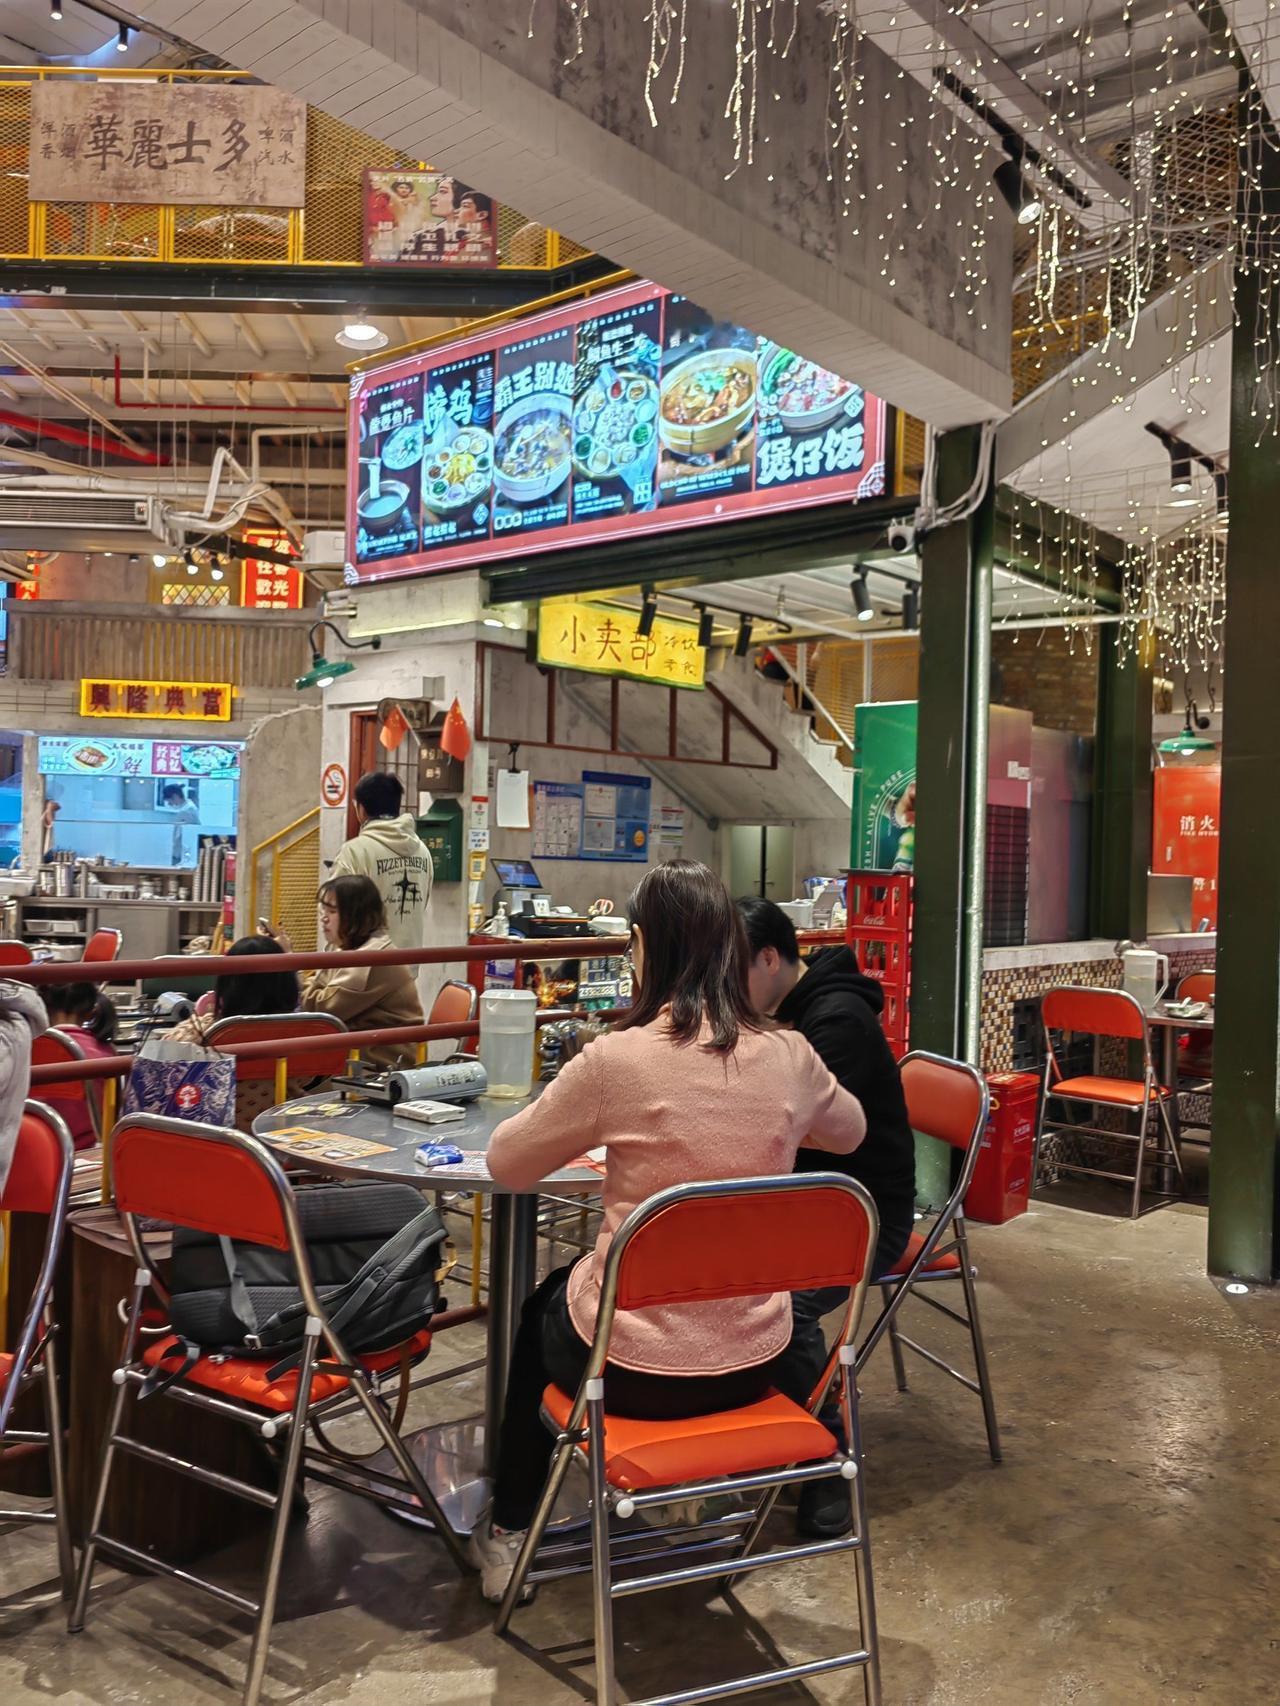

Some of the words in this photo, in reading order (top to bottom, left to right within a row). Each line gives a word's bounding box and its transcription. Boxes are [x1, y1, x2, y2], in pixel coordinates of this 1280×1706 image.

[84, 113, 251, 171] 華麗士多
[756, 422, 865, 485] 煲仔饭
[560, 615, 658, 670] 小卖部
[865, 803, 877, 835] ALIVE
[1179, 815, 1215, 830] 消火
